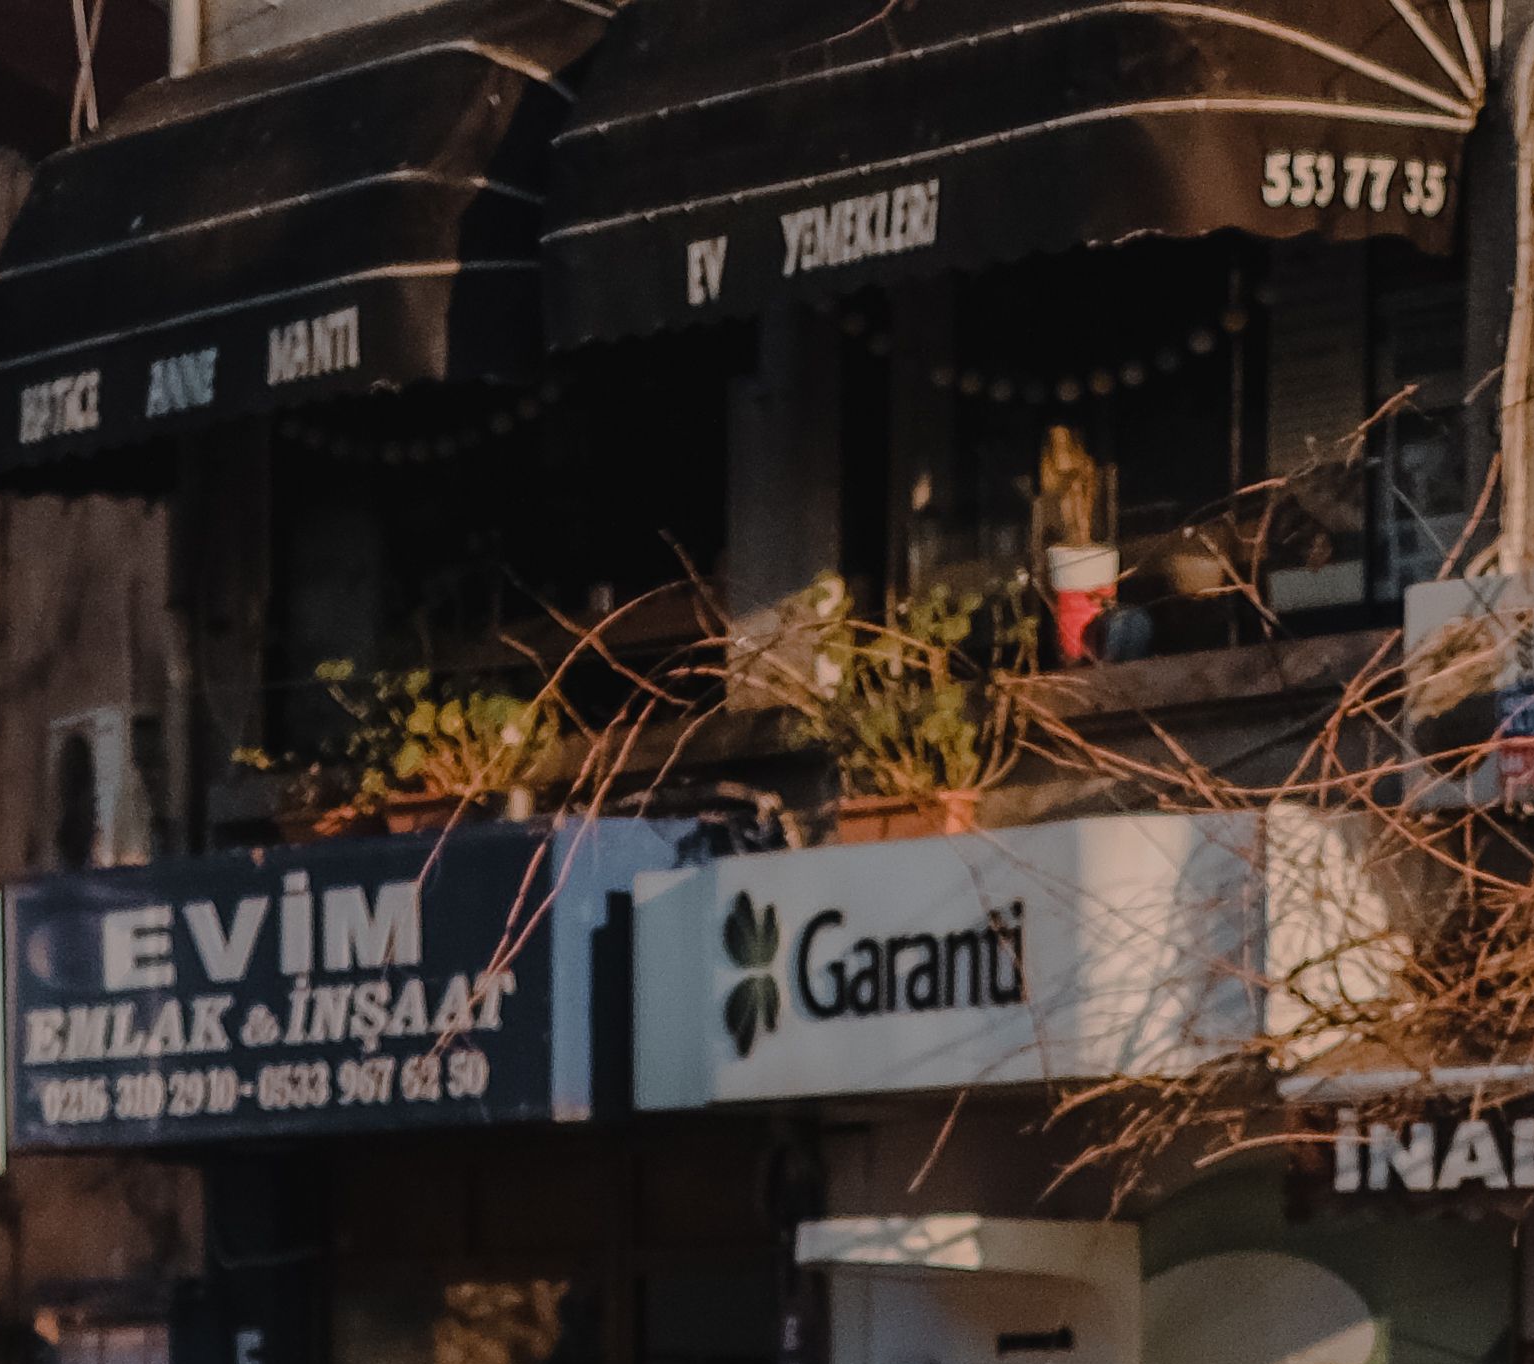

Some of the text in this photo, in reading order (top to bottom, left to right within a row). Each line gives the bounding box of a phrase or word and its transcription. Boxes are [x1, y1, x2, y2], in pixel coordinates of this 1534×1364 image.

[1262, 149, 1448, 217] 553 77 35
[686, 176, 940, 307] EV YEMEKLERİ
[267, 304, 361, 386] MANTI
[102, 872, 422, 991] EVİM
[795, 900, 1026, 1020] Garanti
[23, 968, 517, 1065] EMLAK & İNŞAAT
[40, 1076, 109, 1126] 0216
[446, 1047, 490, 1100] 50
